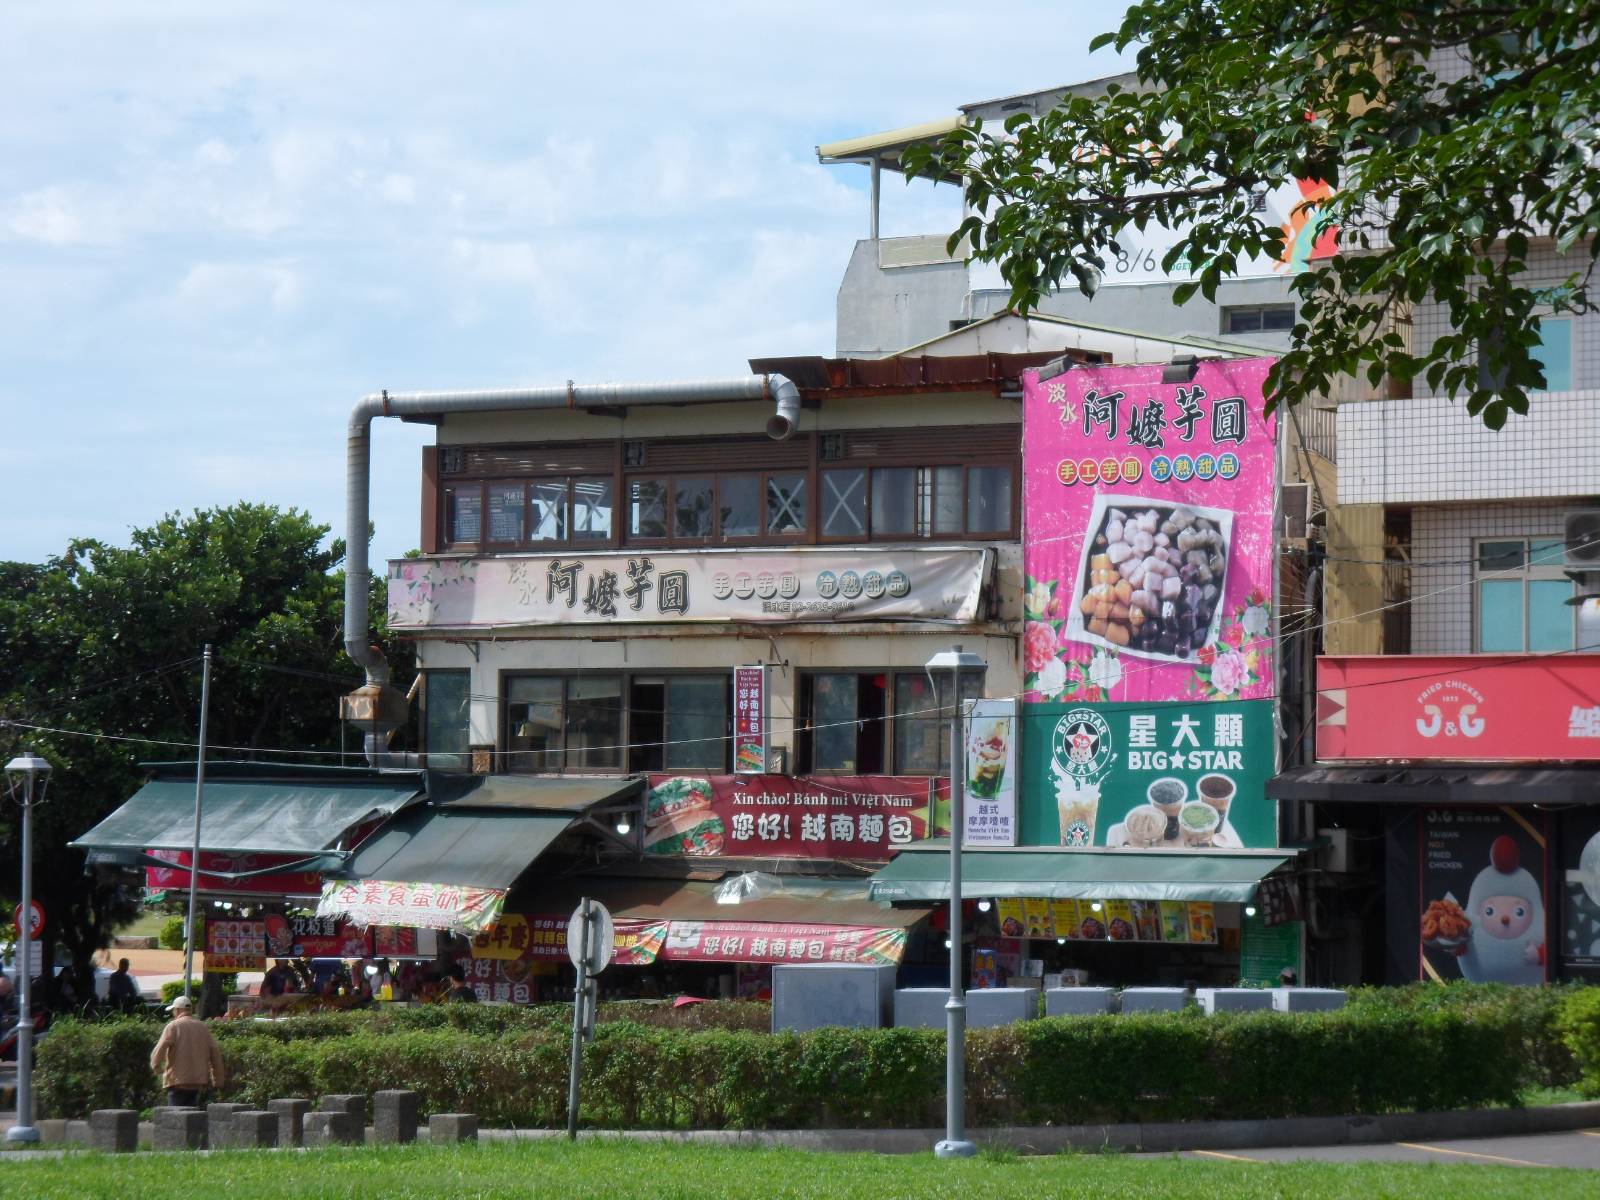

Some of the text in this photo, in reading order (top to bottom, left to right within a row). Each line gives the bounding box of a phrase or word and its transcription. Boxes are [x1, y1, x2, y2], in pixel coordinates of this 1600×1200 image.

[1047, 383, 1077, 423] 淡水
[1082, 384, 1248, 449] 阿嬤芋圓
[1058, 456, 1238, 482] 手工芋圓 冷熱甜品
[506, 561, 538, 606] 淡水
[545, 556, 691, 617] 阿嬤芋圓
[714, 572, 907, 595] 手工芋圓 冷熱甜品
[1416, 680, 1486, 704] FRIED CHICKEN
[1128, 713, 1244, 748] 星大顆
[1415, 704, 1486, 738] J&G
[733, 791, 754, 805] Xin
[756, 791, 790, 806] chào!
[793, 792, 828, 806] Bánh
[882, 794, 913, 808] Nam
[978, 804, 999, 815] 越式
[731, 812, 913, 844] 您好! 越南麵包
[1429, 831, 1460, 839] TAIWAN
[1428, 851, 1452, 859] FRIED
[1428, 861, 1463, 869] CHICKEN
[749, 936, 826, 960] 越南麵包
